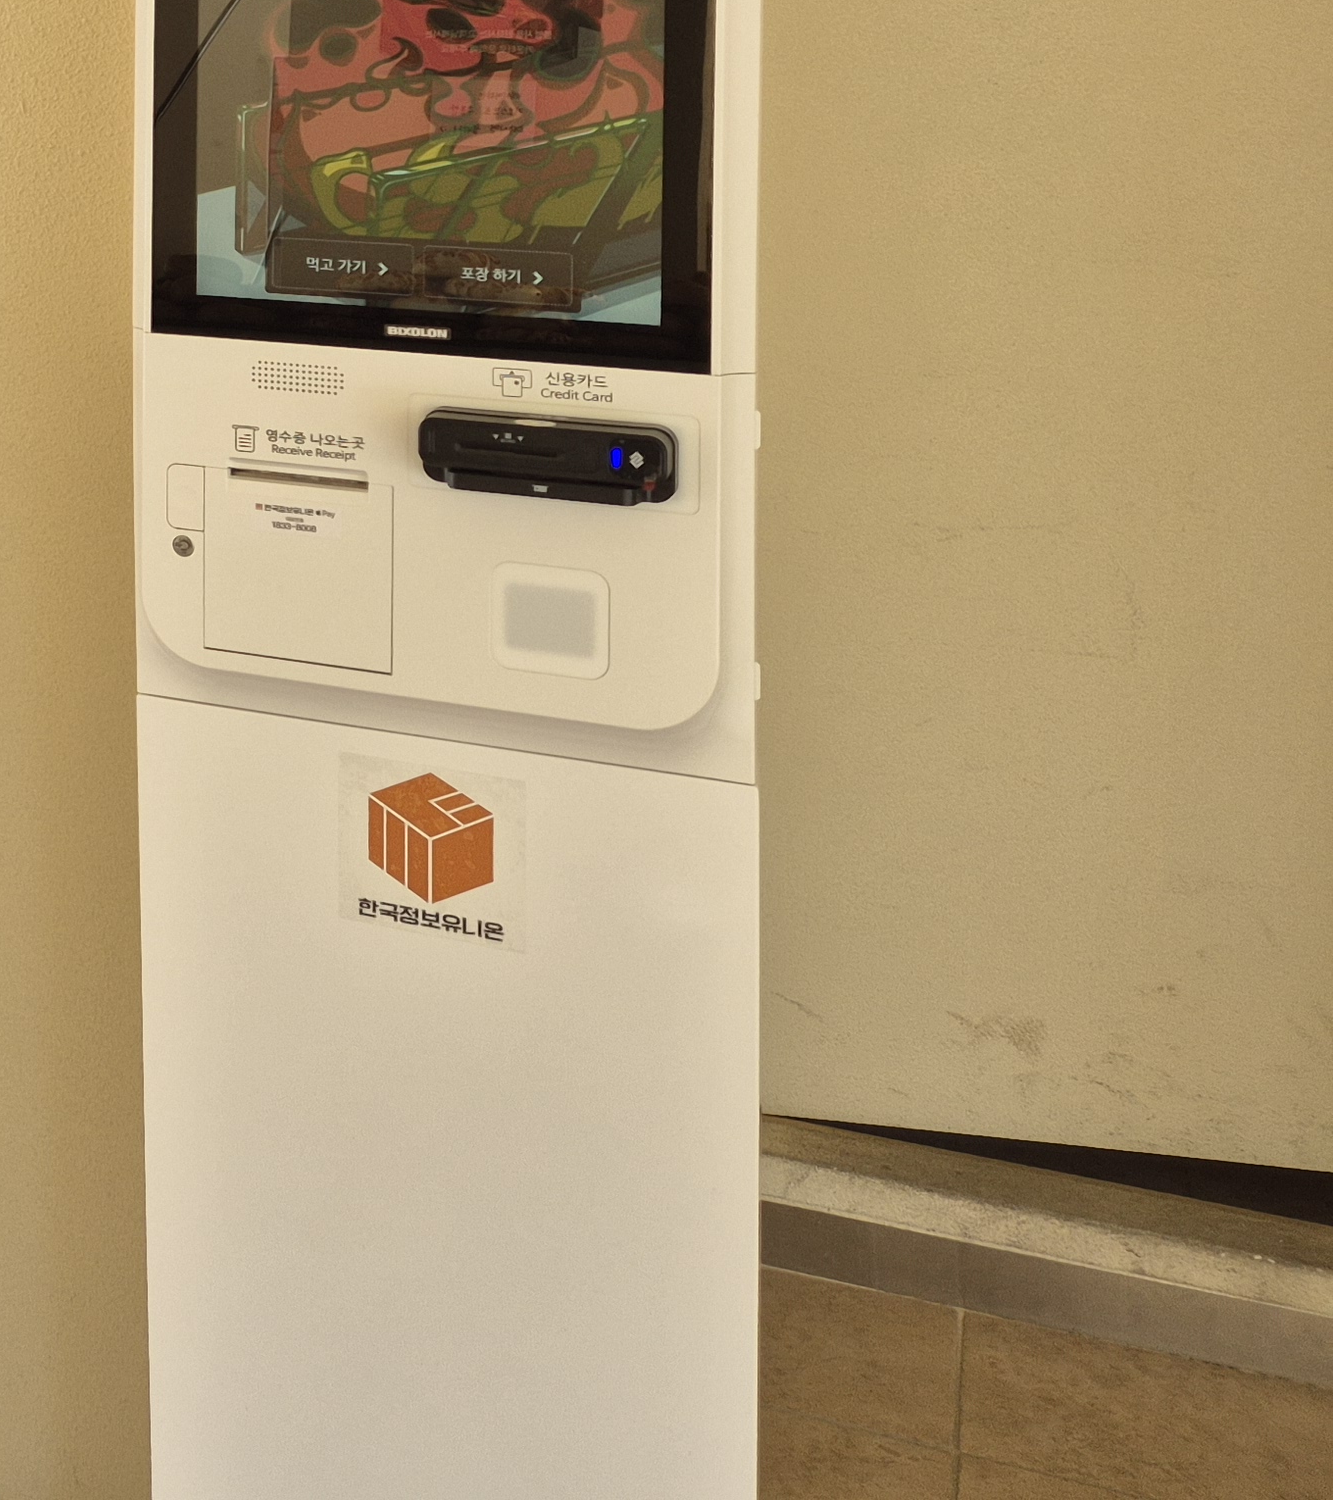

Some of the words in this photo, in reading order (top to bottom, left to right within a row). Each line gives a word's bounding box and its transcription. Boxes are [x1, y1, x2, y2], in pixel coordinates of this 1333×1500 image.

[306, 257, 333, 273] 먹고
[337, 259, 366, 275] 가기
[460, 266, 489, 282] 포장
[493, 268, 521, 284] 하기
[386, 326, 448, 339] BIXOLON
[545, 372, 608, 388] 신용카드
[540, 388, 579, 401] Credit
[583, 391, 613, 403] Card
[266, 429, 307, 445] 영수증
[271, 444, 313, 457] Receive
[315, 448, 356, 462] Receipt
[357, 897, 505, 943] 한국정보유니온
